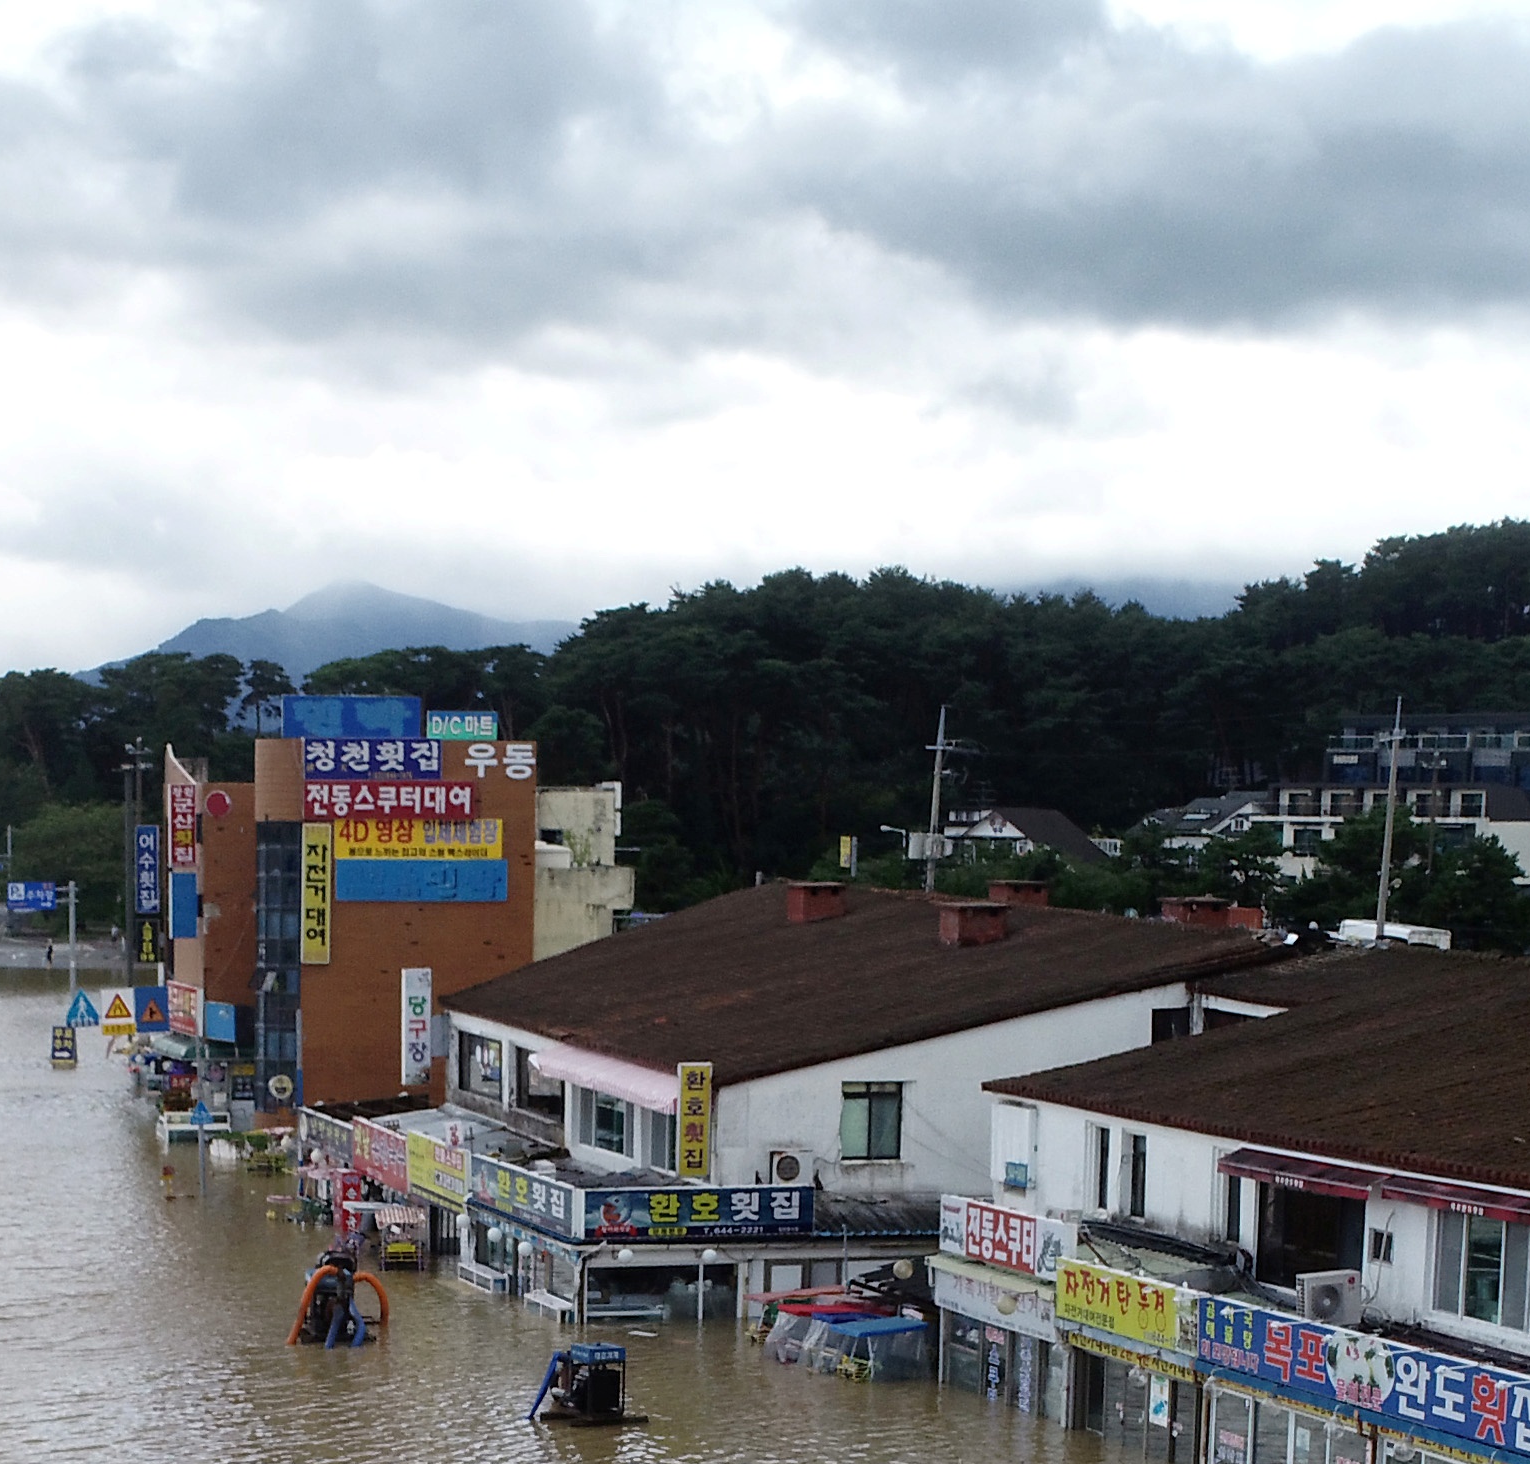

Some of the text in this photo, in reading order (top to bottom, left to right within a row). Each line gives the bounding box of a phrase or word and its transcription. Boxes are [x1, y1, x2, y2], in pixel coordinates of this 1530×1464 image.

[432, 715, 494, 736] D/C 마트
[464, 742, 536, 780] 우동
[306, 783, 472, 817] 전동스쿠터대여
[339, 818, 369, 843] 4D
[375, 817, 413, 844] 영상
[306, 843, 328, 946] 자전거대여
[408, 995, 427, 1063] 당구장
[684, 1071, 705, 1169] 환호횟집
[497, 1169, 565, 1220] 환호횟집
[648, 1191, 801, 1224] 환호횟집
[967, 1206, 1036, 1271] 전동스쿠터
[1064, 1269, 1110, 1308] 자전거
[1115, 1280, 1132, 1316] 탄
[1263, 1319, 1326, 1384] 목포
